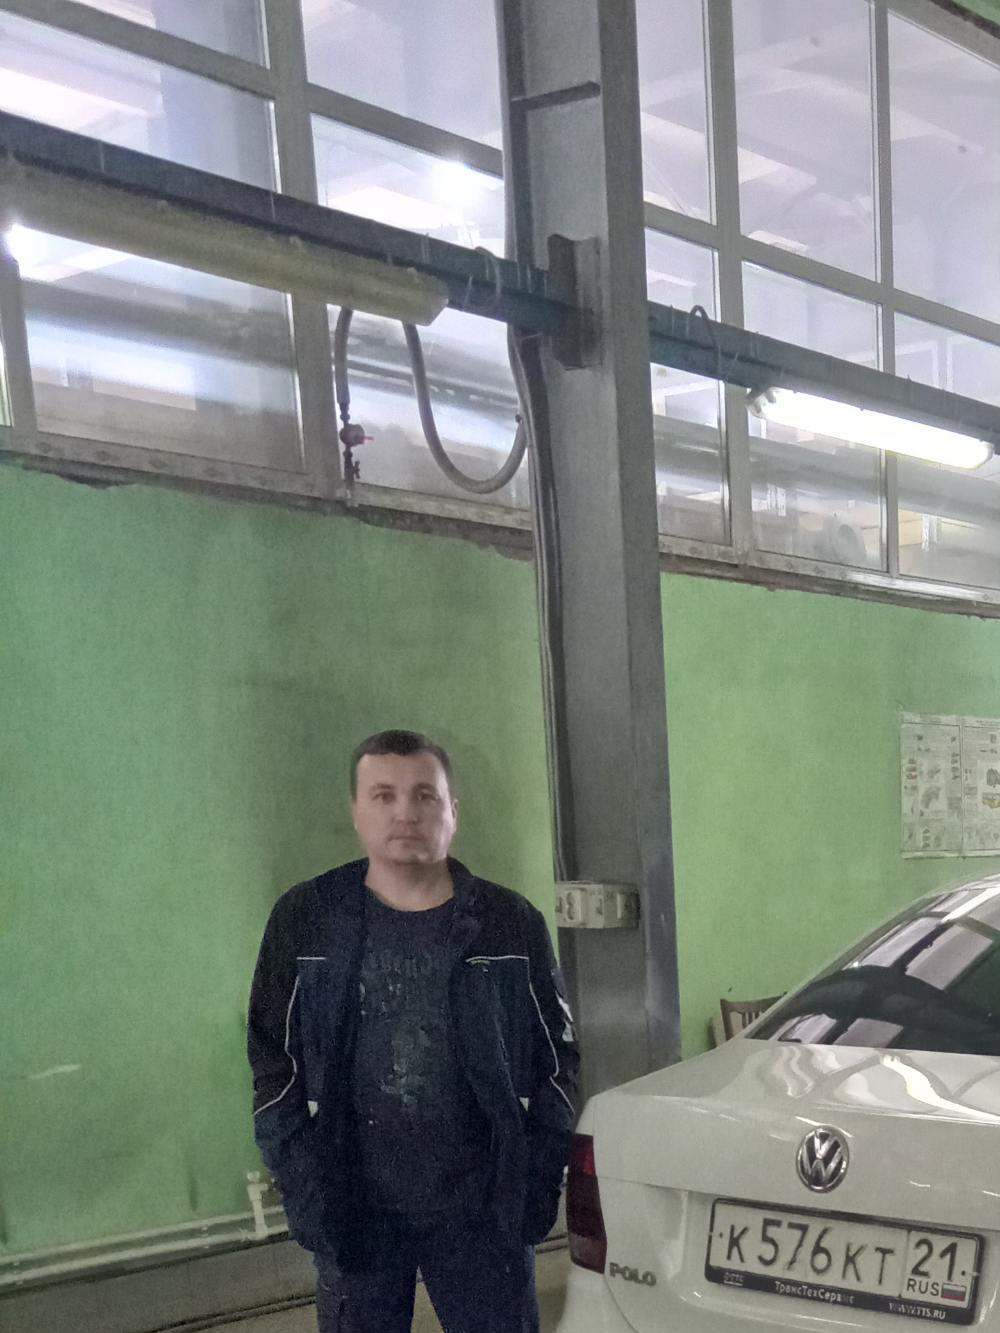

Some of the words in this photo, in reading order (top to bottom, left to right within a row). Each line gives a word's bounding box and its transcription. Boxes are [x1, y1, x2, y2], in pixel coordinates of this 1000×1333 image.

[911, 1238, 958, 1282] 21
[609, 1262, 657, 1287] POLO
[906, 1278, 940, 1297] RUS
